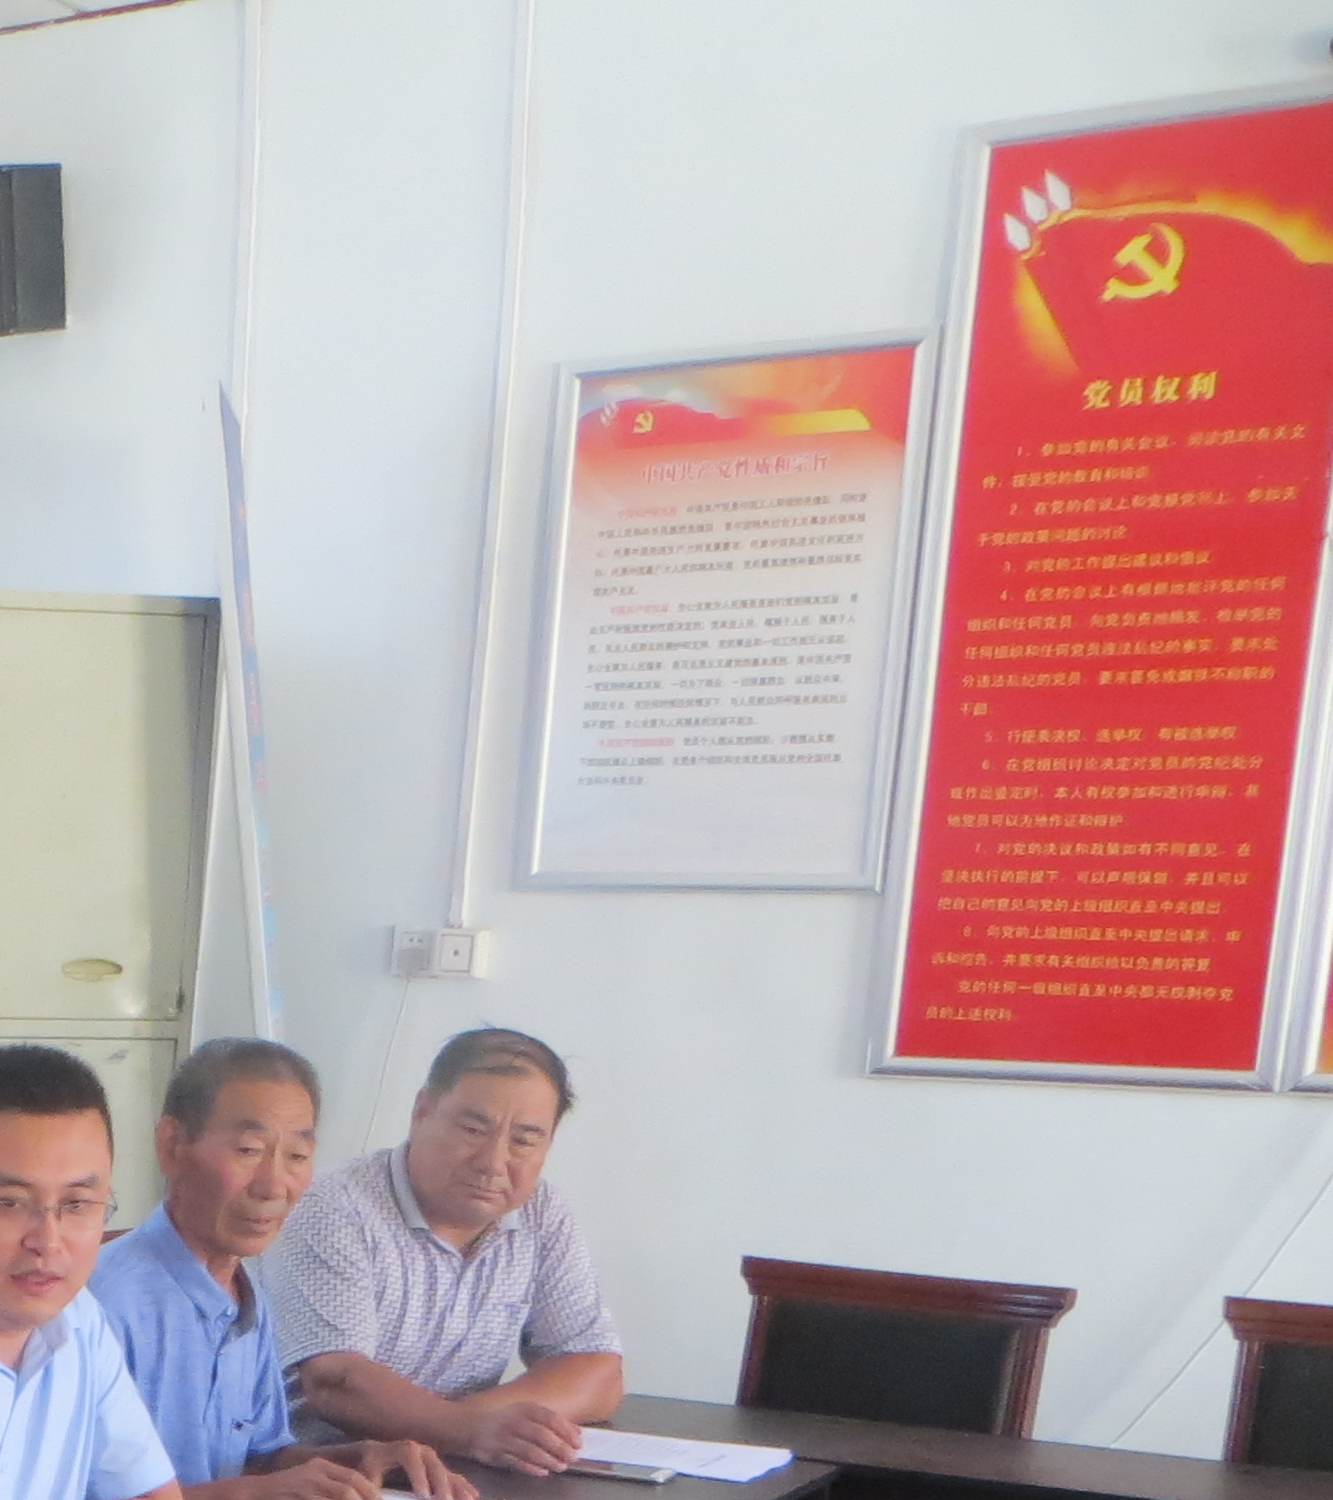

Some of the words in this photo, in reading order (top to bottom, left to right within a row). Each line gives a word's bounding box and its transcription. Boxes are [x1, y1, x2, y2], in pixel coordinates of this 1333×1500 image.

[1081, 370, 1219, 411] 党员权利
[642, 452, 830, 485] 中国共产党性质和宗旨
